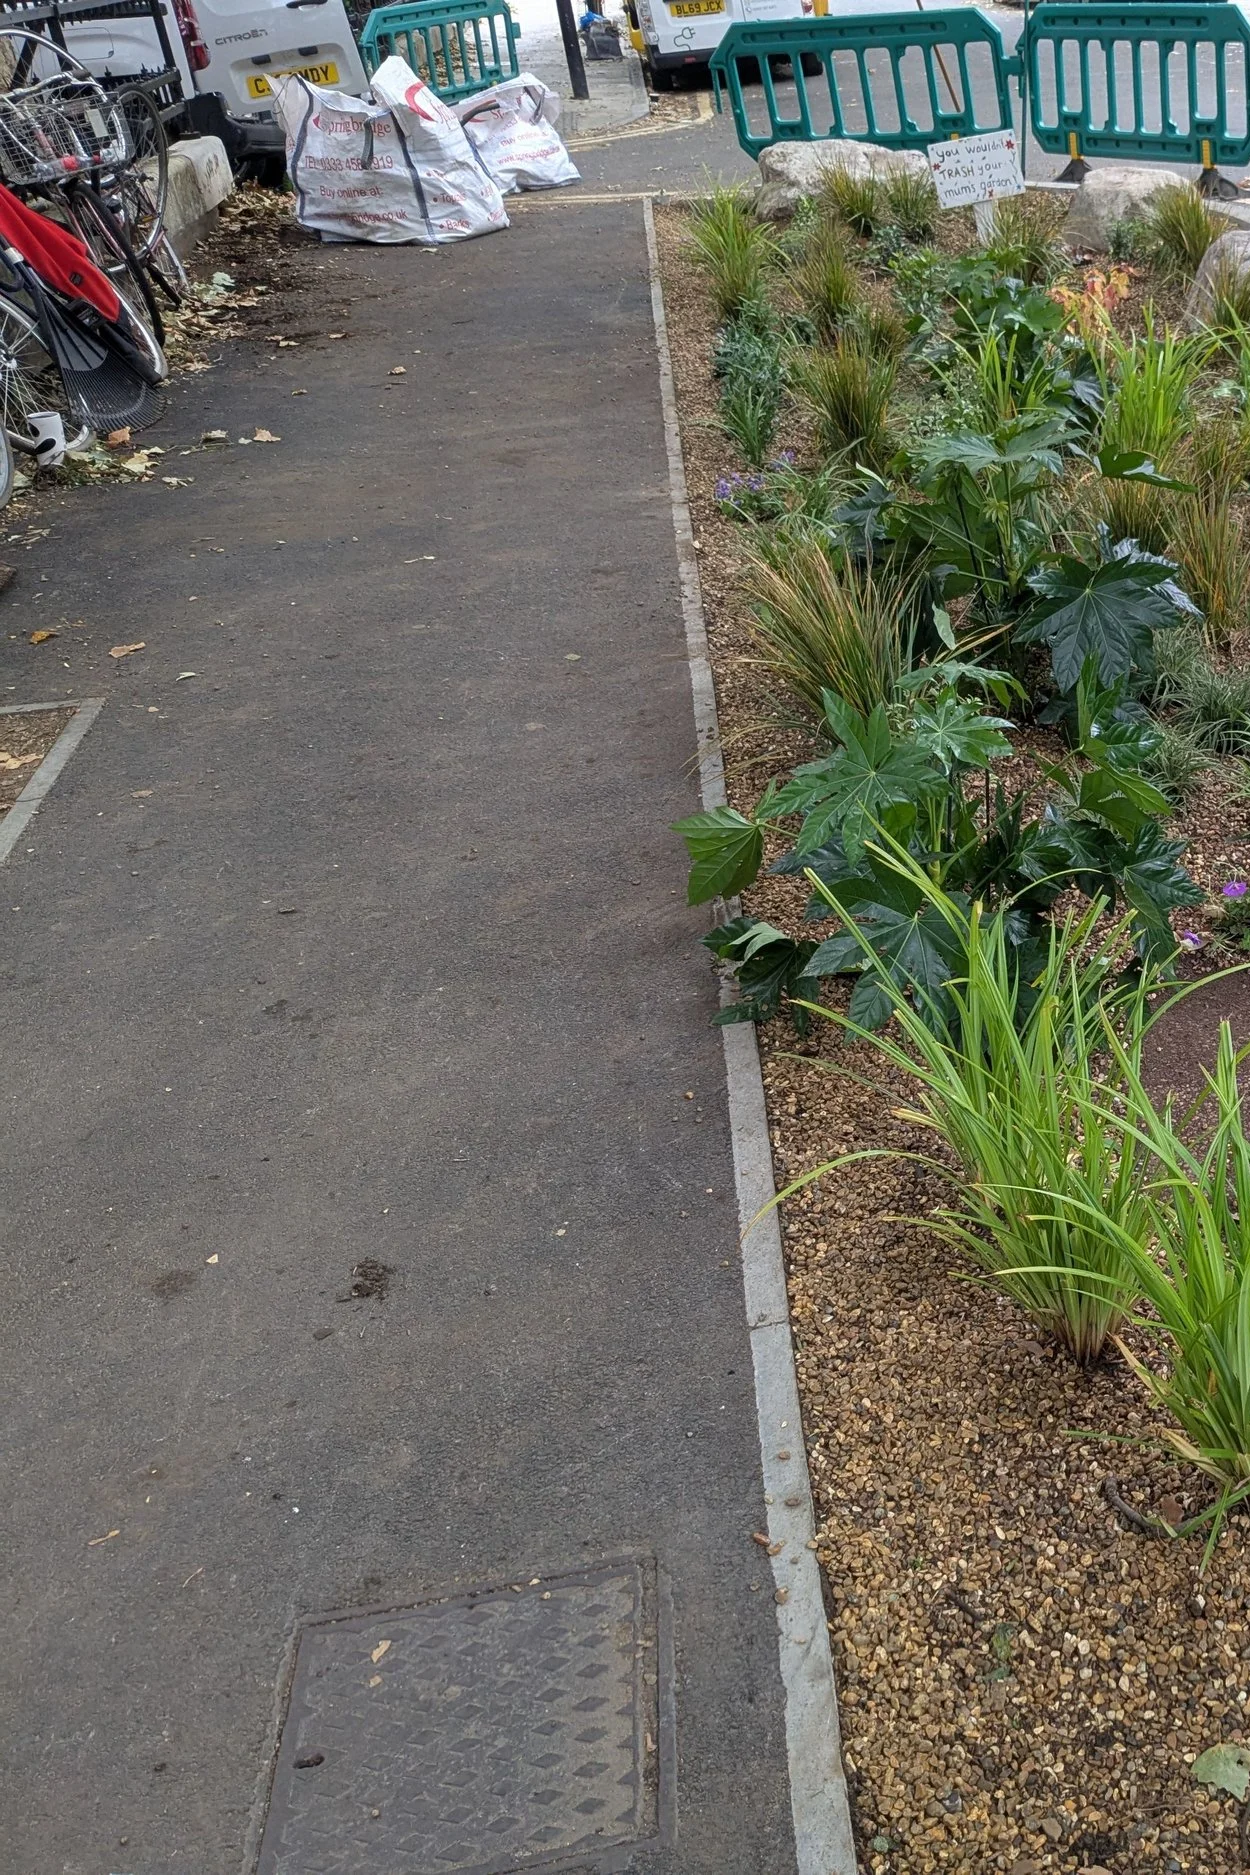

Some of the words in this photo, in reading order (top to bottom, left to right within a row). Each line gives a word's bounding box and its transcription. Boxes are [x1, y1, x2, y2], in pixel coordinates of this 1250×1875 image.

[675, 3, 701, 15] BL69
[703, 1, 723, 12] JCX
[214, 28, 269, 46] CITROËN
[938, 165, 975, 180] TRASH
[976, 161, 1002, 176] your
[319, 185, 335, 199] Buy
[337, 187, 367, 199] online
